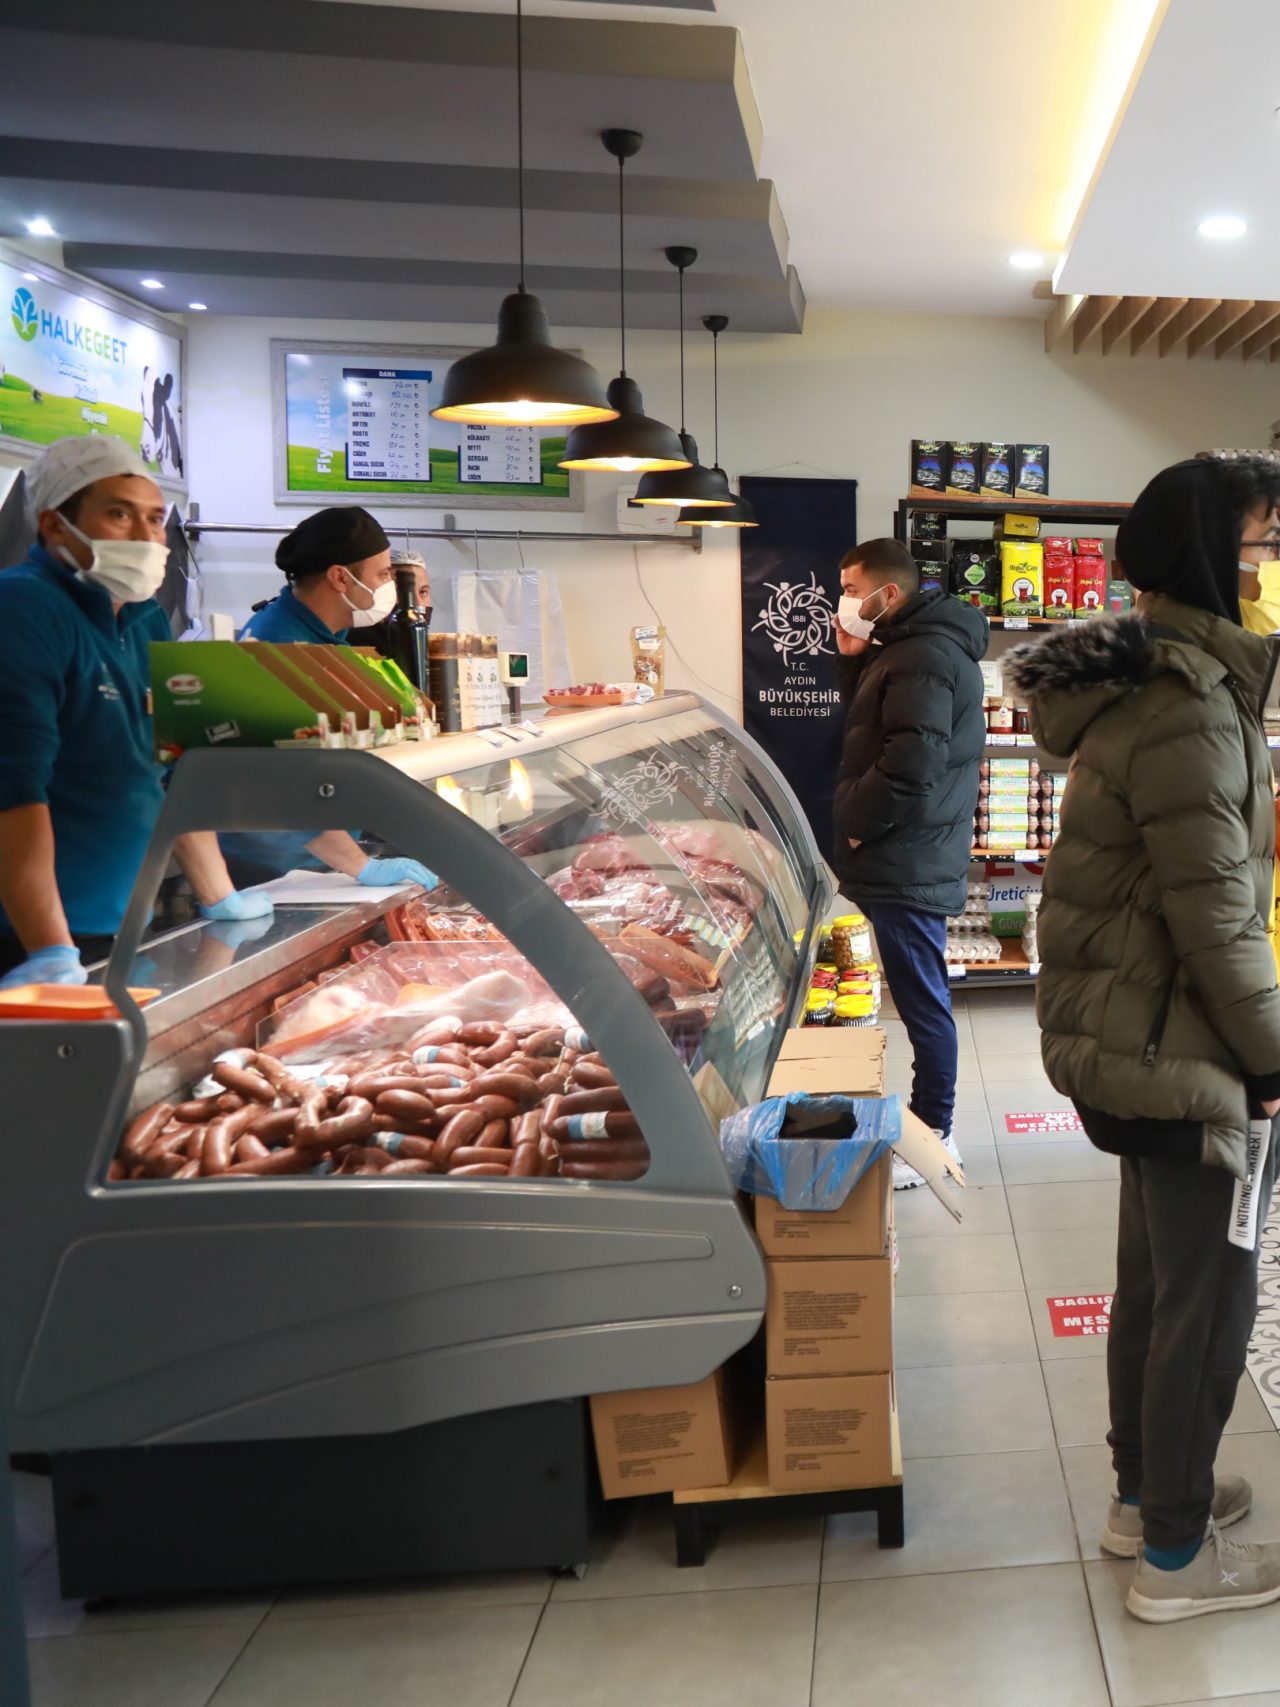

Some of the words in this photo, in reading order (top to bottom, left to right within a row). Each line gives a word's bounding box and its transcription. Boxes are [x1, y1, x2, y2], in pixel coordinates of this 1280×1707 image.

[41, 310, 128, 365] HALKEGEET
[792, 615, 806, 623] 1881
[790, 662, 809, 671] T.C.
[784, 676, 816, 685] AYDIN
[759, 688, 841, 706] BÜYÜKŞEHİR
[770, 706, 831, 717] BELEDİYESİ
[1236, 1183, 1253, 1228] NOTHING
